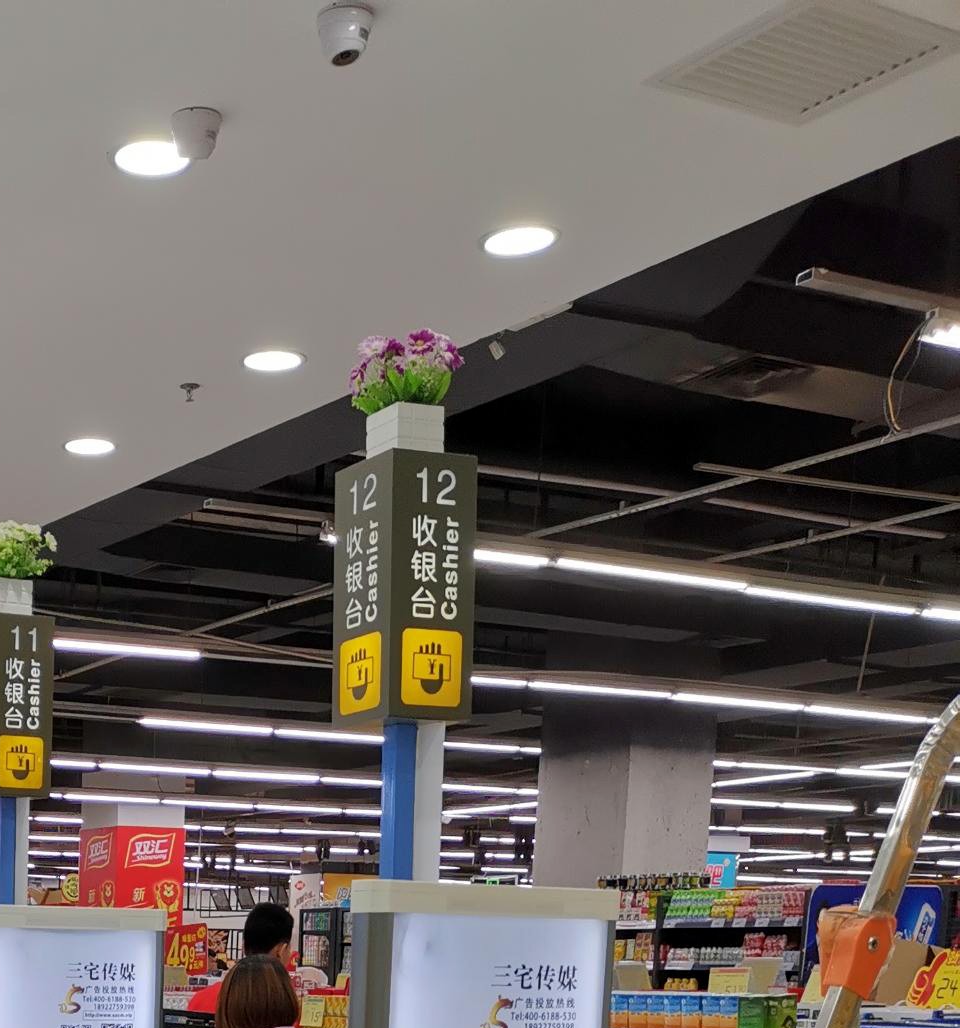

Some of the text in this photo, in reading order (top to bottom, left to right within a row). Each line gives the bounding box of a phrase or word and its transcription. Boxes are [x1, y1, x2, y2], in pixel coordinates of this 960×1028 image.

[349, 473, 377, 515] 12
[416, 466, 456, 507] 12
[345, 525, 364, 630] 收银台
[364, 519, 380, 623] Cashier
[411, 514, 438, 619] 收银台
[440, 516, 460, 621] Cashier
[10, 625, 37, 652] 11
[4, 657, 25, 729] 收银台
[26, 659, 41, 730] Cashier
[132, 839, 168, 857] 双汇
[66, 962, 135, 981] 三宅传媒
[491, 964, 578, 991] 三宅传媒
[511, 1011, 577, 1021] Tel:400-6188-530
[514, 997, 576, 1009] 广告投放热线
